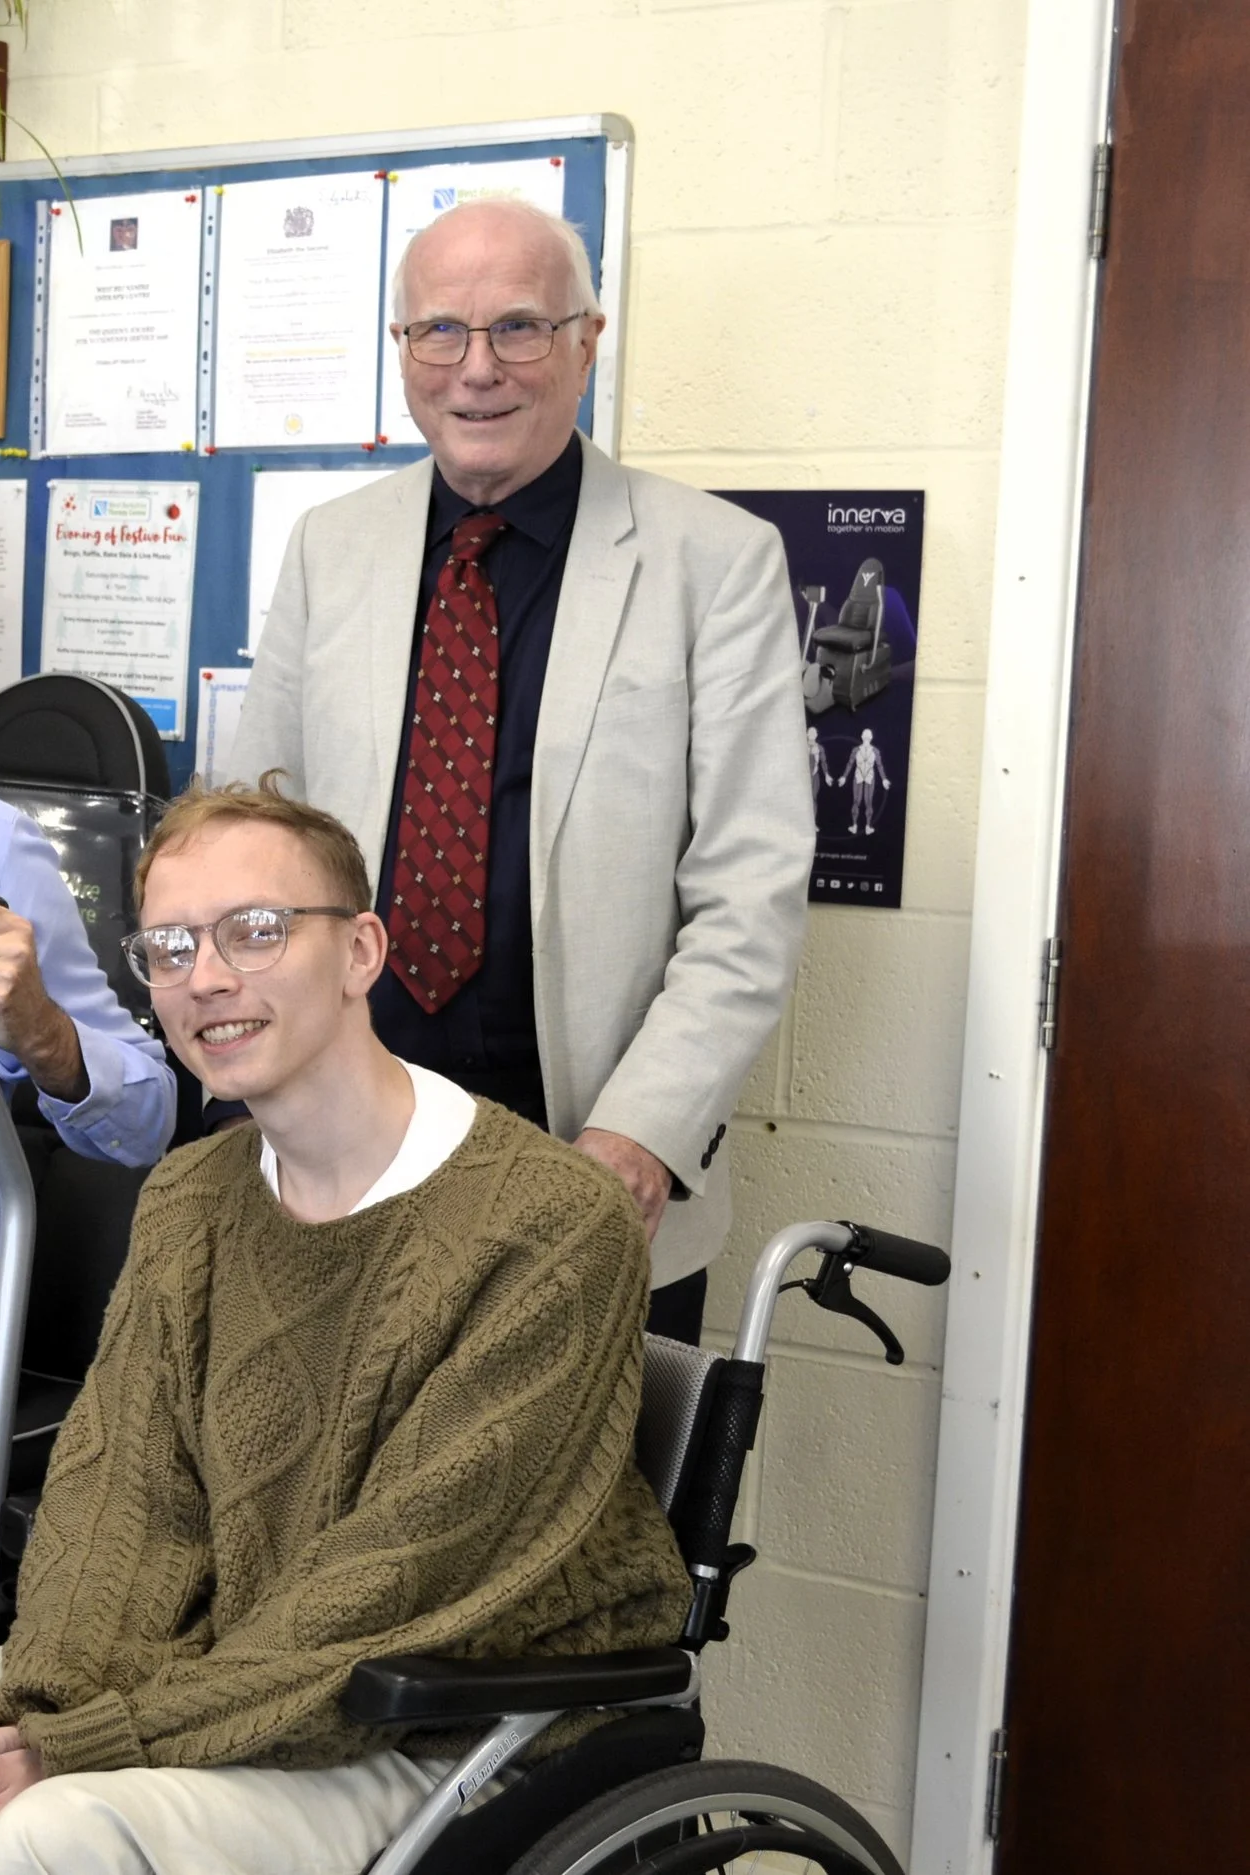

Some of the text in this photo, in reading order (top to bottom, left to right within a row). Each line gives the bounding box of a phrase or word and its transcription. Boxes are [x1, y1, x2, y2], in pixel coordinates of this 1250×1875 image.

[827, 503, 906, 524] innerva
[56, 523, 188, 546] Evening of Festive Fun
[827, 524, 905, 534] together in motion
